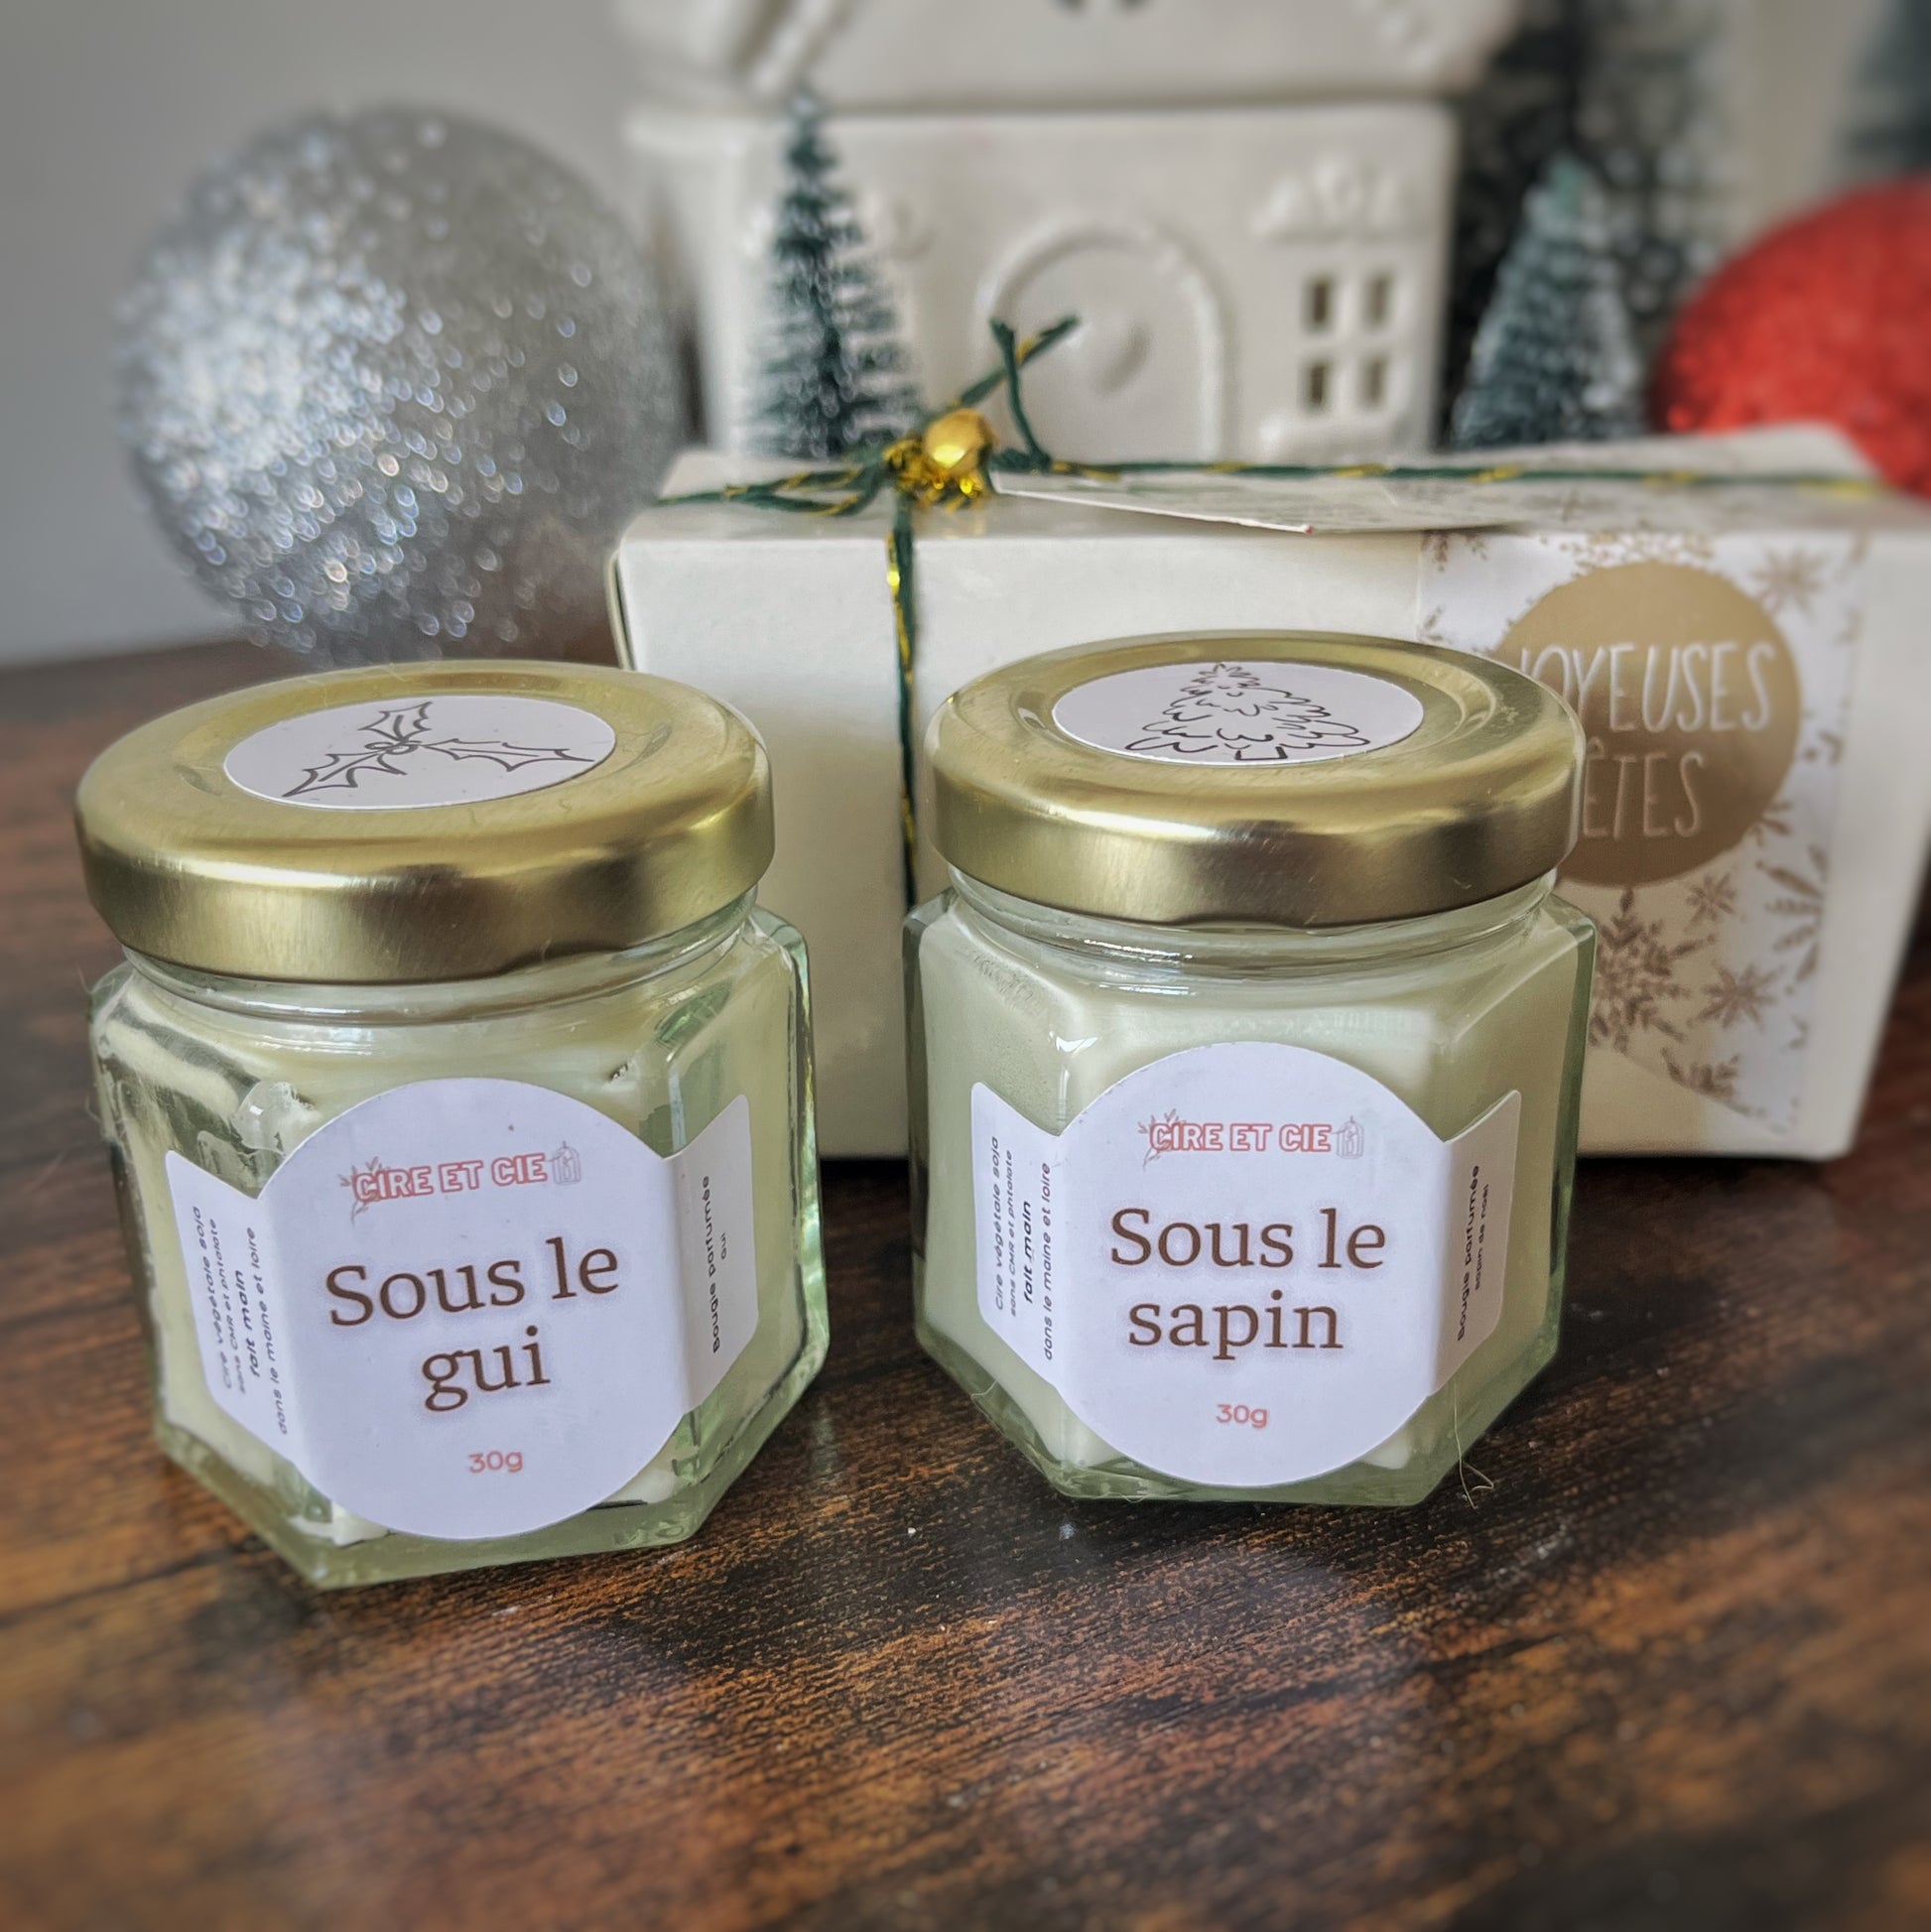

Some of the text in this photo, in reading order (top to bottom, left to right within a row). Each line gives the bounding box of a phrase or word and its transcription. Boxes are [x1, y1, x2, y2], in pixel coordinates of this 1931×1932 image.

[1520, 640, 1777, 733] OYEUSES
[1583, 736, 1705, 840] ÊTES
[352, 1152, 548, 1204] CIRE ET CIE
[1149, 1121, 1333, 1152] CIRE ET CIE
[991, 1136, 1004, 1311] Cire végétale soja
[1004, 1150, 1014, 1217] phtalate
[209, 1219, 229, 1291] phtalate
[703, 1176, 720, 1353] Bougie parfumée
[1008, 1220, 1015, 1238] et
[1022, 1201, 1034, 1304] fait main
[1042, 1162, 1053, 1360] dans le maine et loire
[1110, 1208, 1386, 1269] Sous le
[1457, 1165, 1480, 1342] Bougie parfumée
[193, 1207, 231, 1389] Cire végétale soja
[222, 1292, 232, 1311] et
[235, 1270, 260, 1377] fait main
[324, 1236, 620, 1327] Sous le
[1128, 1290, 1345, 1361] sapin
[226, 1315, 238, 1351] CMR
[247, 1226, 288, 1435] dans le maine et loire
[421, 1324, 552, 1414] gui
[1217, 1404, 1269, 1429] 30g
[467, 1450, 525, 1475] 30g
